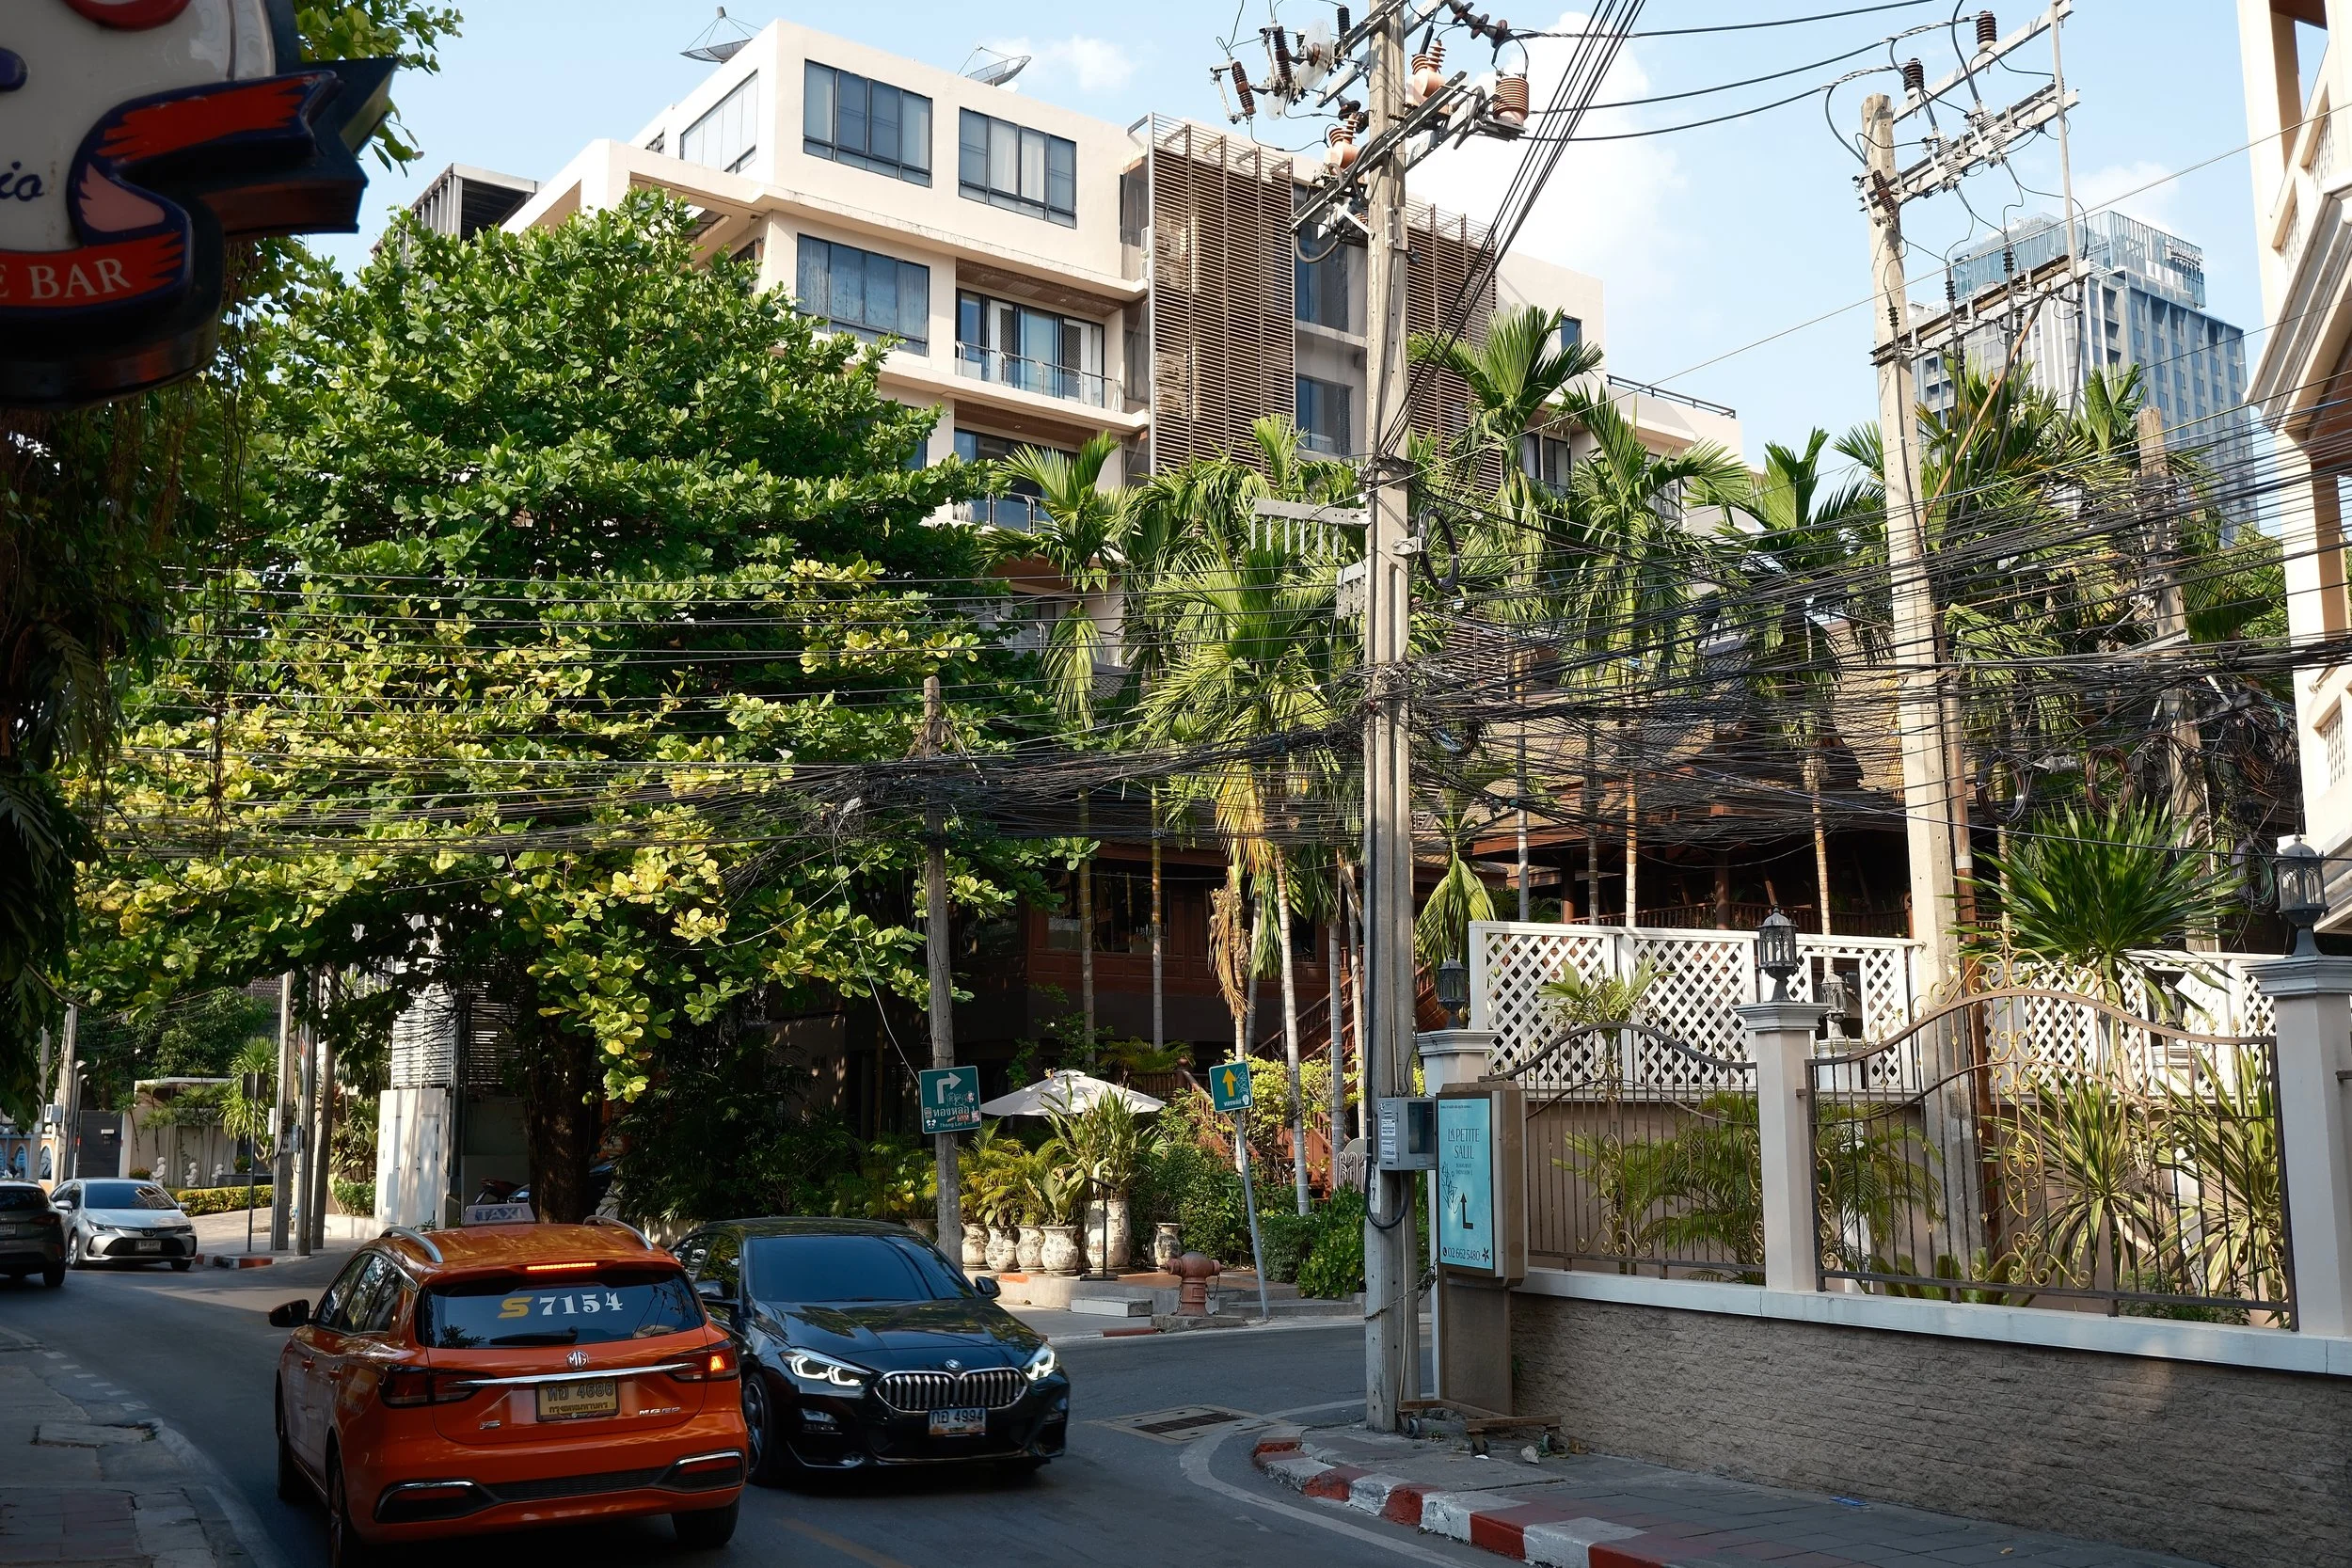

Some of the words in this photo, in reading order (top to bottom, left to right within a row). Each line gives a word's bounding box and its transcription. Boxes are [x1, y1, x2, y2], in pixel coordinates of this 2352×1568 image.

[28, 259, 132, 299] BAR
[1455, 1128, 1480, 1143] PETITE
[1454, 1145, 1474, 1160] SALIL
[477, 1207, 523, 1221] TAXI
[498, 1296, 533, 1319] S
[539, 1292, 623, 1316] 7154
[567, 1351, 588, 1370] MG
[577, 1381, 614, 1399] 4686
[954, 1408, 984, 1422] 4994
